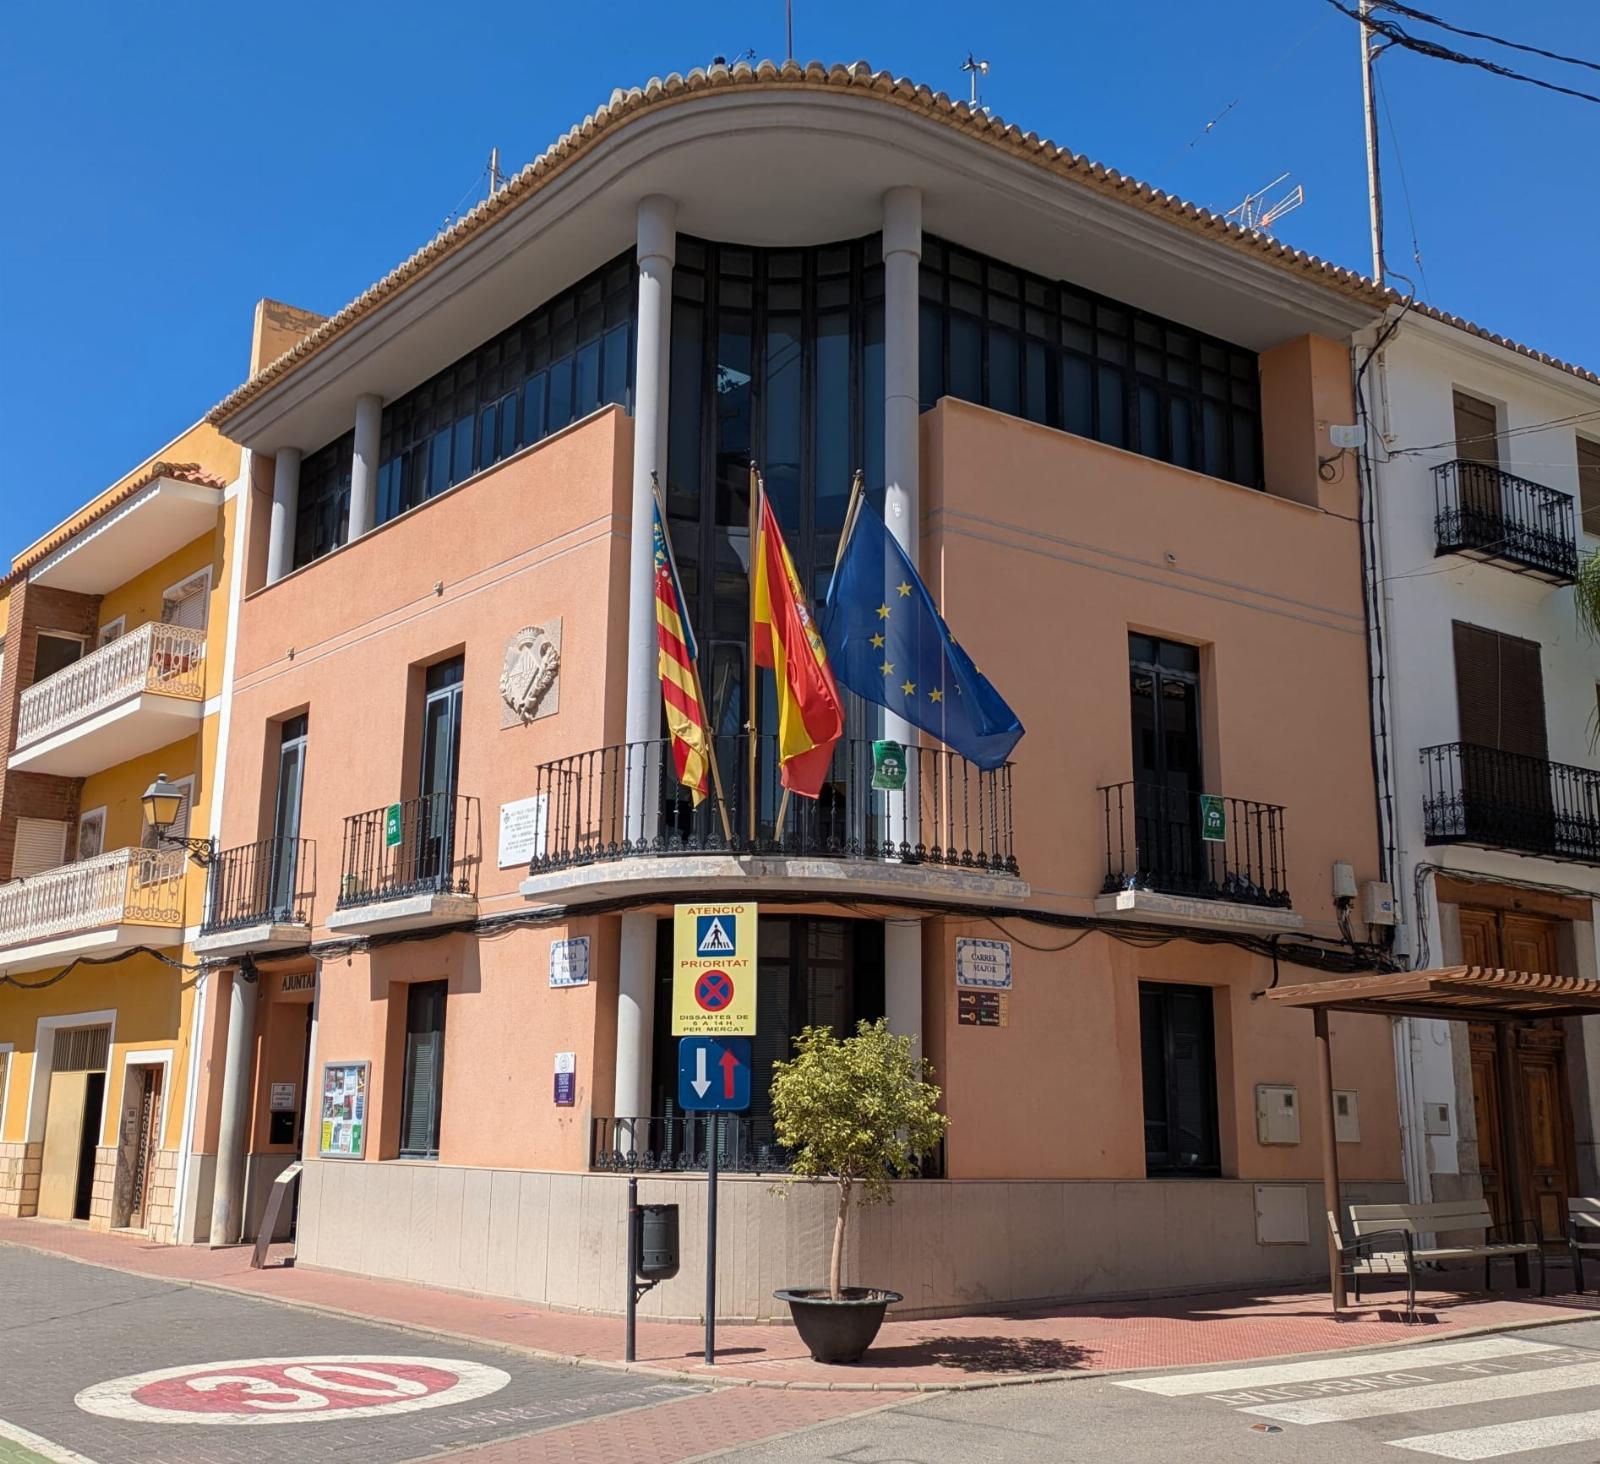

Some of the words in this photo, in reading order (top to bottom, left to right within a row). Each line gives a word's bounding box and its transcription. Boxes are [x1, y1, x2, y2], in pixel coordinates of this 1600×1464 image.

[687, 905, 745, 915] ATENCIÓ
[971, 953, 997, 962] CARRER
[680, 959, 749, 969] PRIORITAT
[972, 964, 997, 973] MAJOR
[1445, 1362, 1519, 1374] LA
[185, 1365, 429, 1410] 30
[1204, 1373, 1435, 1406] DIVERSITAT
